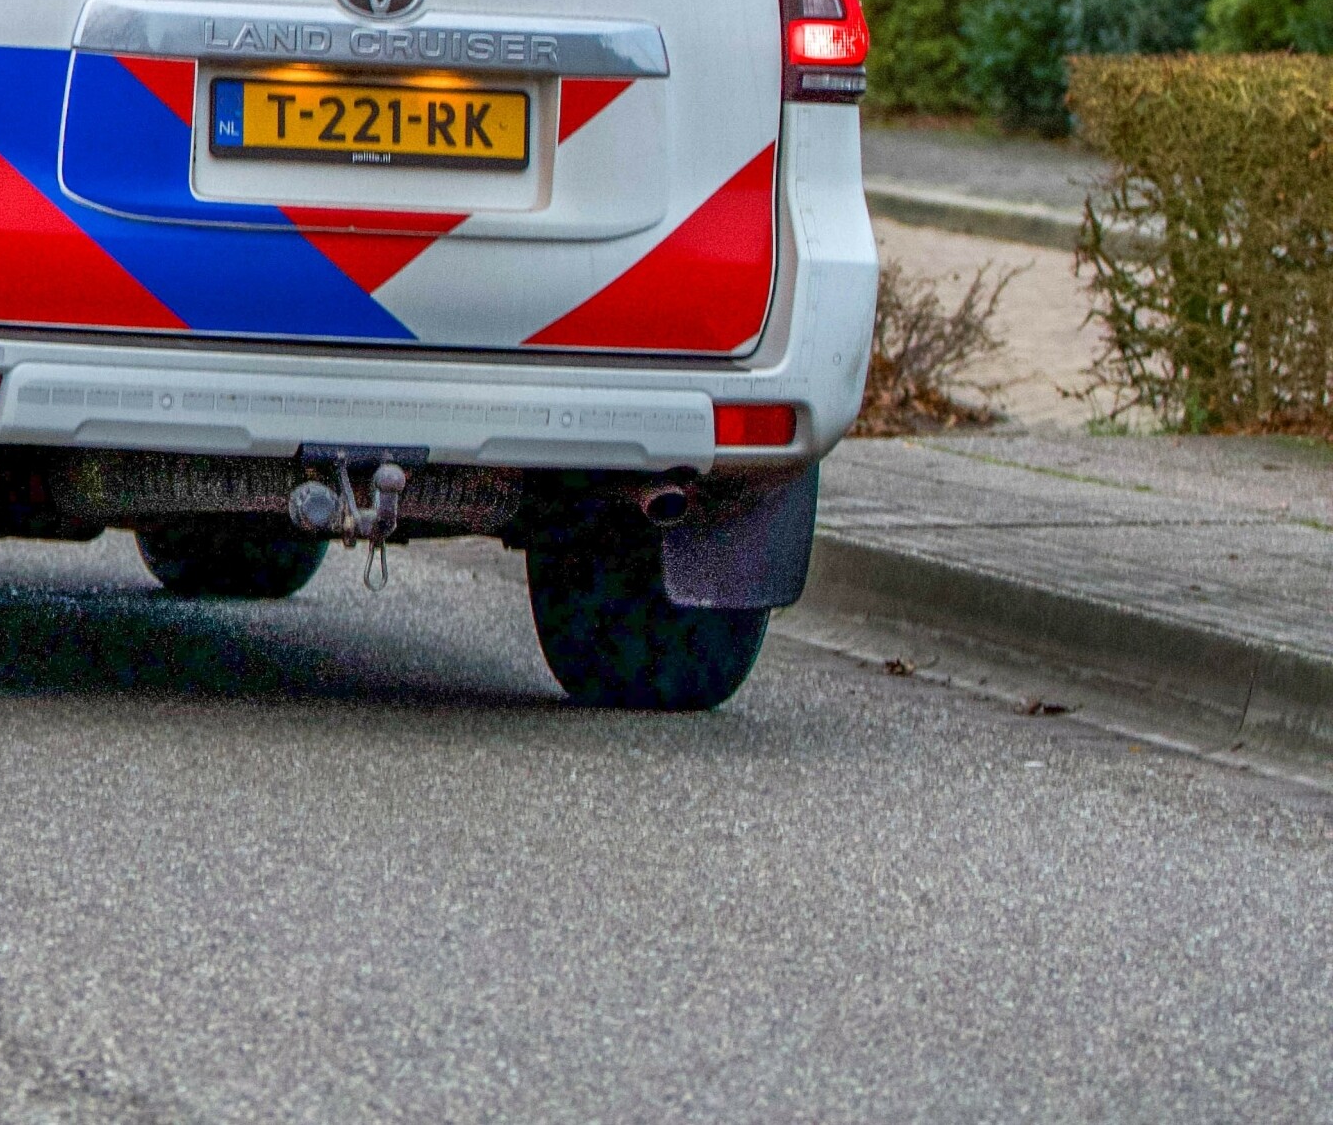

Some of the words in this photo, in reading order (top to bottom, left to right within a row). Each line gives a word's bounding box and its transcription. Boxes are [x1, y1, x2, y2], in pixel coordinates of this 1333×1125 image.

[203, 18, 333, 55] LAND
[348, 27, 560, 66] CRUISER
[218, 119, 240, 137] NL
[266, 92, 494, 149] T-221-RK
[351, 150, 391, 164] politie.nl
